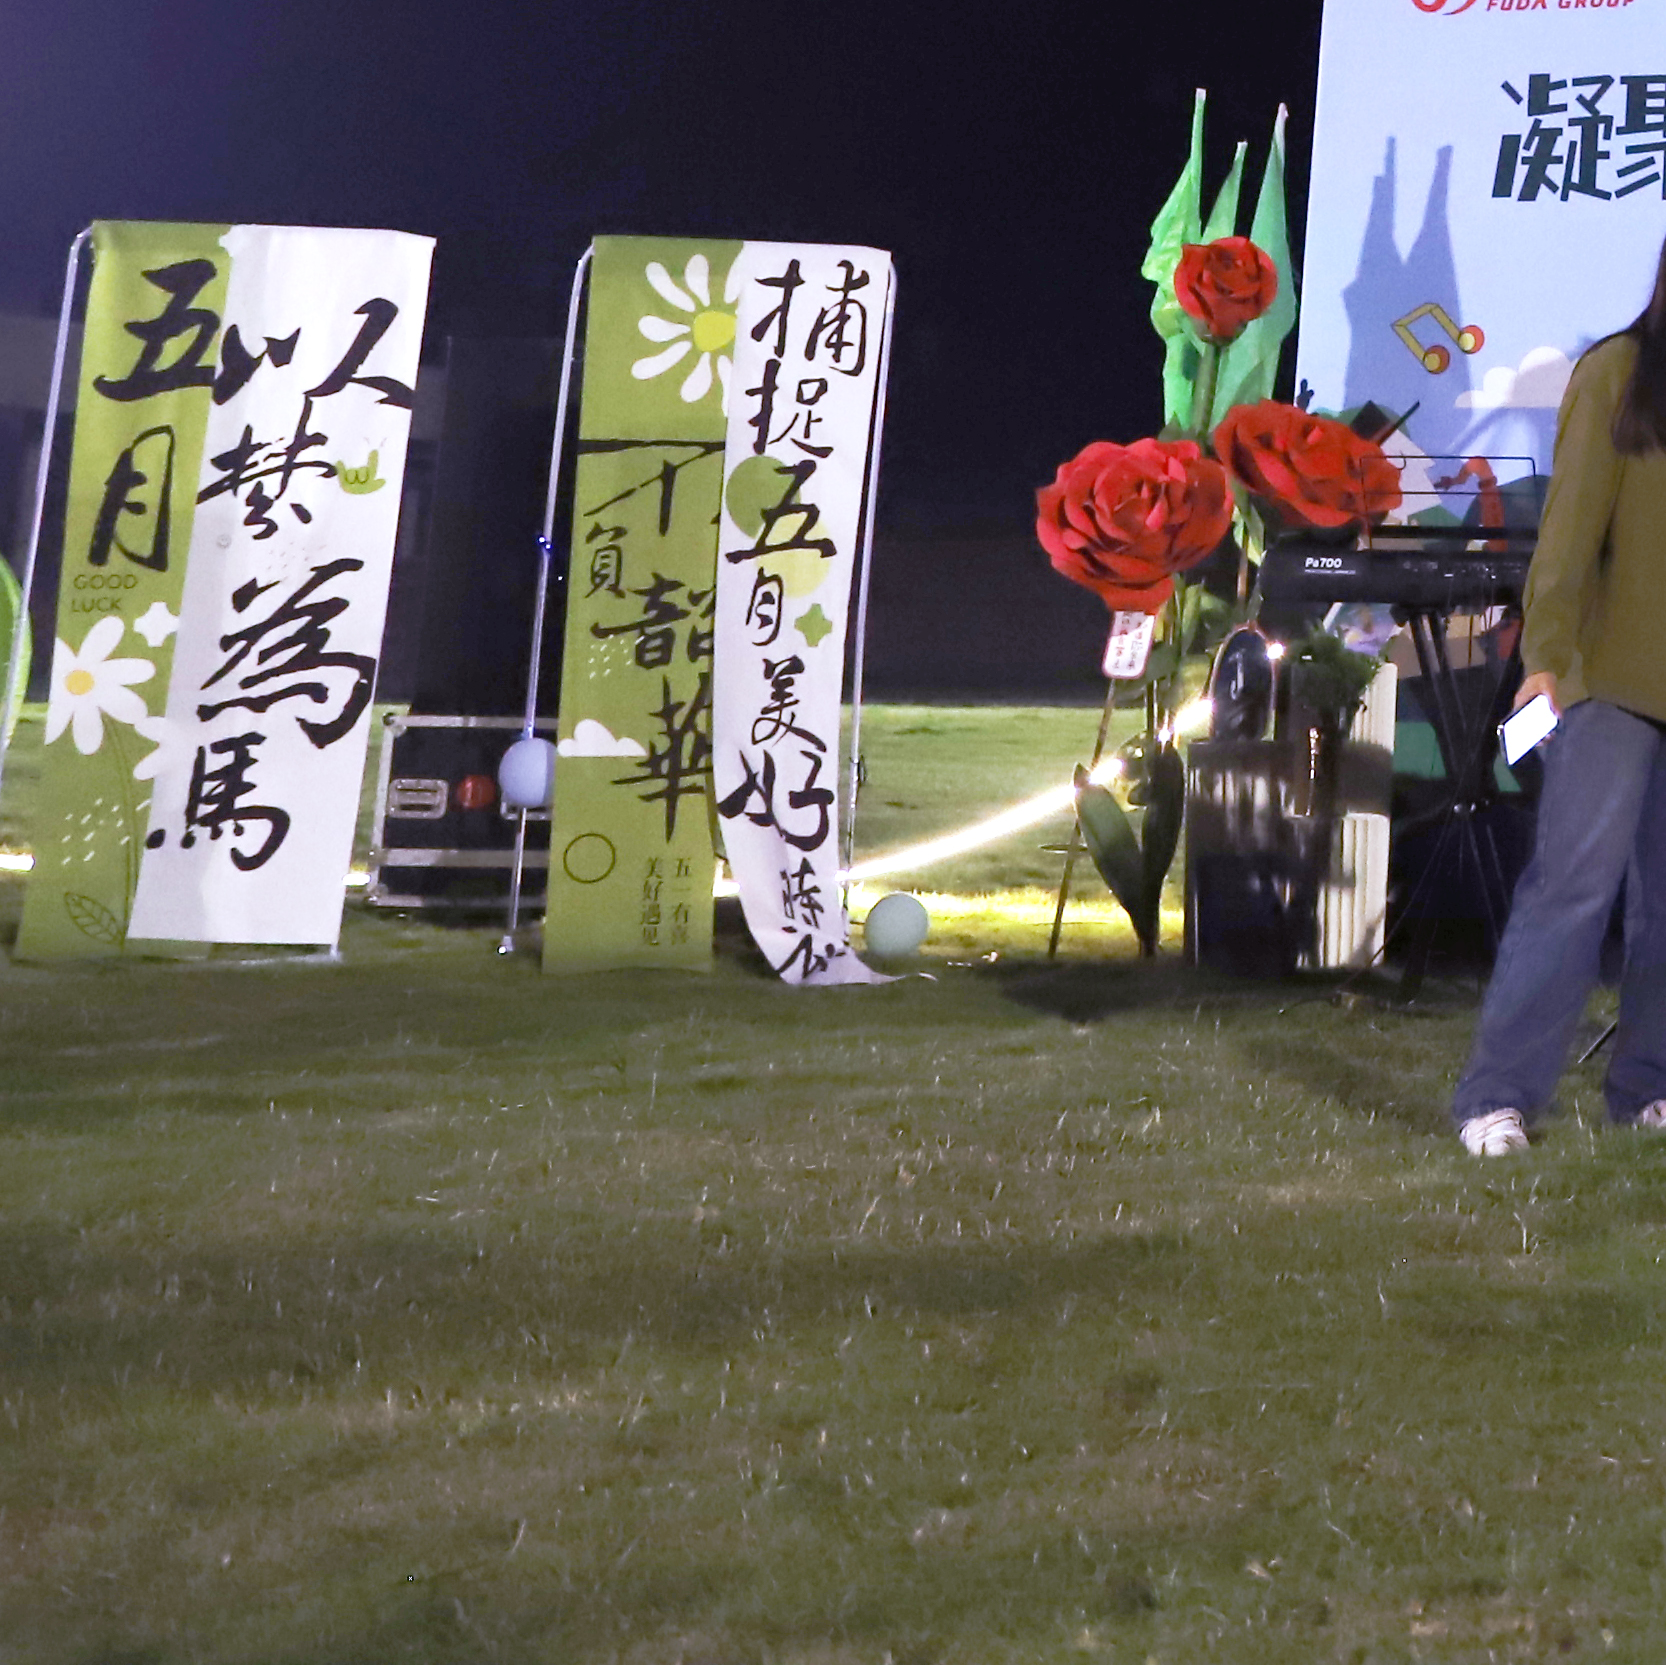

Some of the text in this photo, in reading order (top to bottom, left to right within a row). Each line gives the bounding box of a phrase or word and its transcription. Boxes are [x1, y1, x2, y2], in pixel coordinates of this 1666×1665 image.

[87, 258, 219, 573] 五月
[1304, 557, 1343, 569] Pa700
[72, 573, 139, 590] GOOD
[71, 597, 122, 613] LUCK
